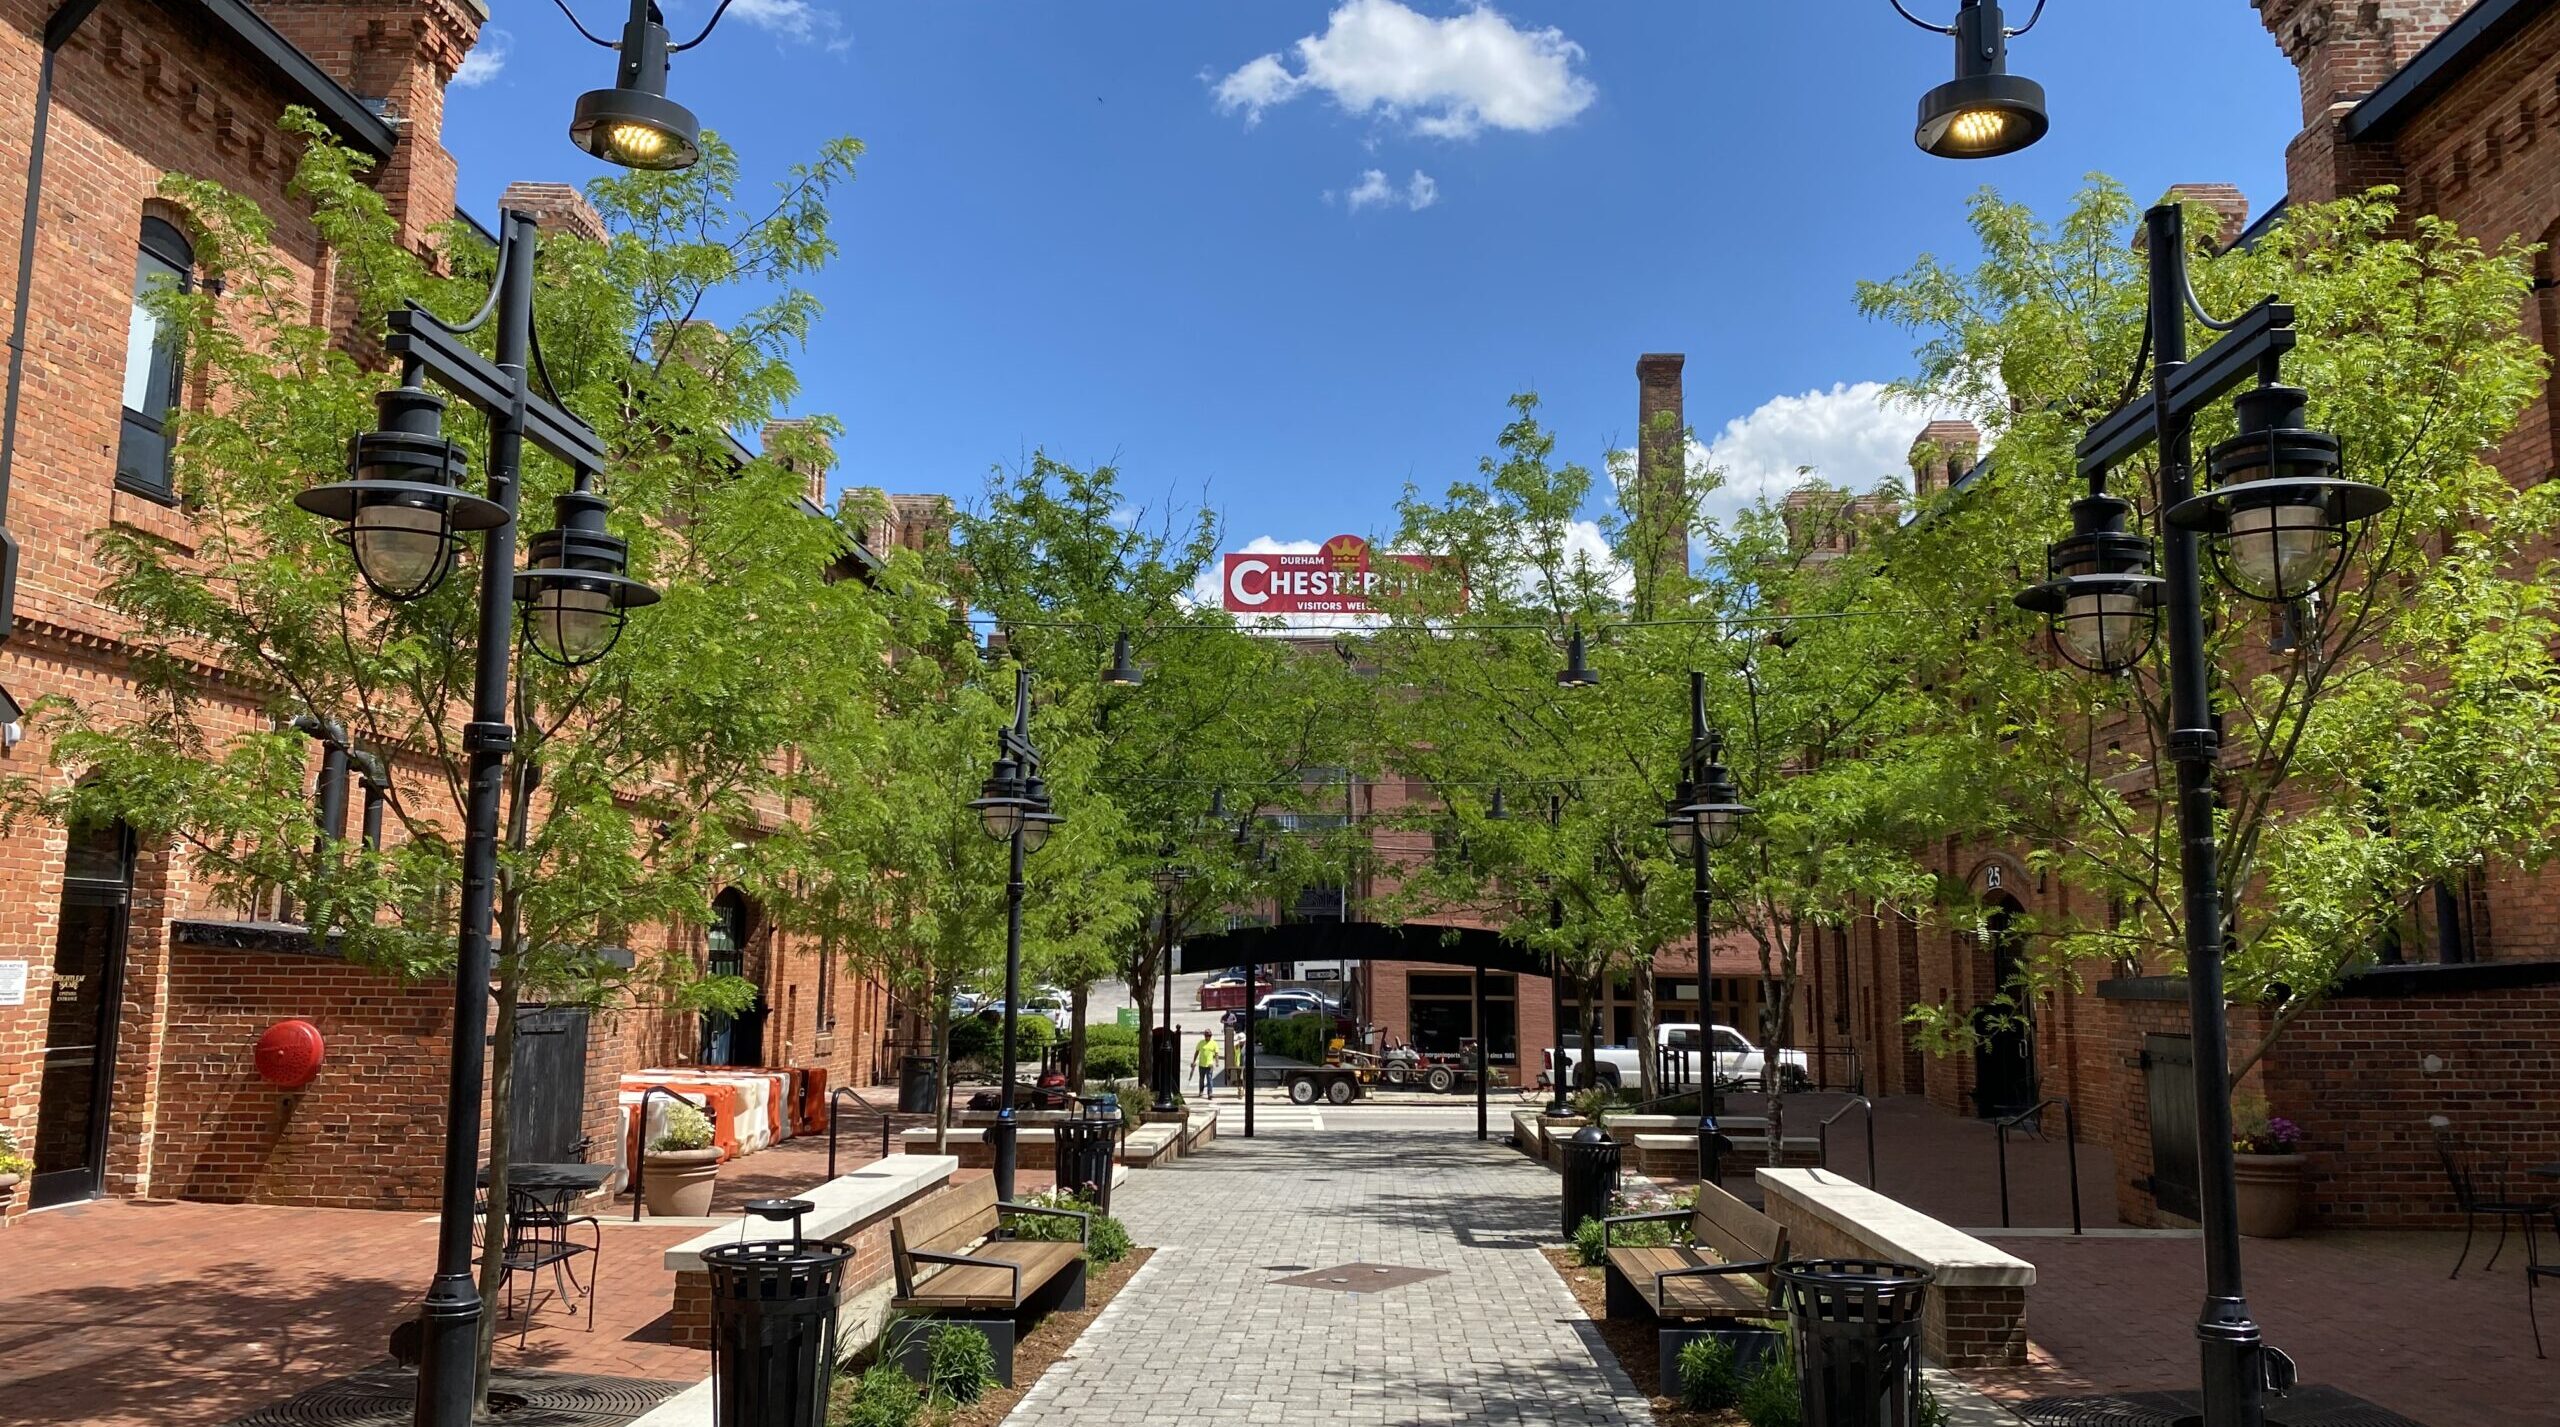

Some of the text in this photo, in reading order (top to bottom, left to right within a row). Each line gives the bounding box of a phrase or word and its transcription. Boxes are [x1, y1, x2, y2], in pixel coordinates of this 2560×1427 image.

[1280, 556, 1325, 565] DURHAM
[1297, 601, 1342, 611] VISITORS
[1987, 866, 2001, 887] 25
